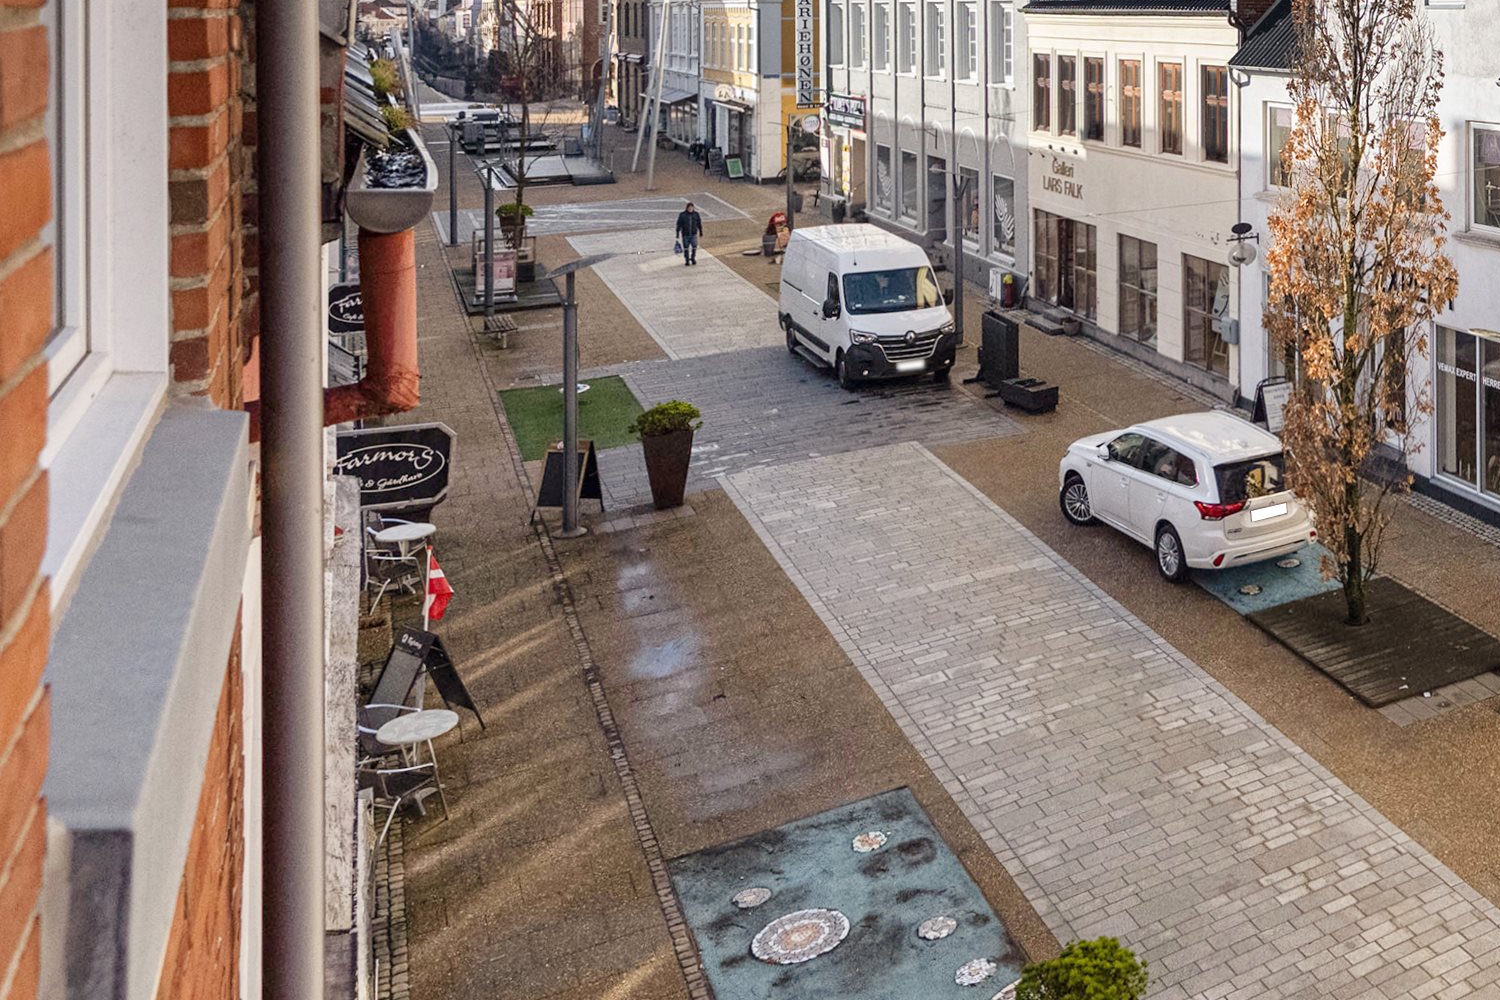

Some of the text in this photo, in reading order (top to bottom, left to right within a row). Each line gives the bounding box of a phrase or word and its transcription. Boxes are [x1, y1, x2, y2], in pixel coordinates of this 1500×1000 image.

[1043, 175, 1083, 200] LARS FALK
[1456, 367, 1477, 382] EXPERT
